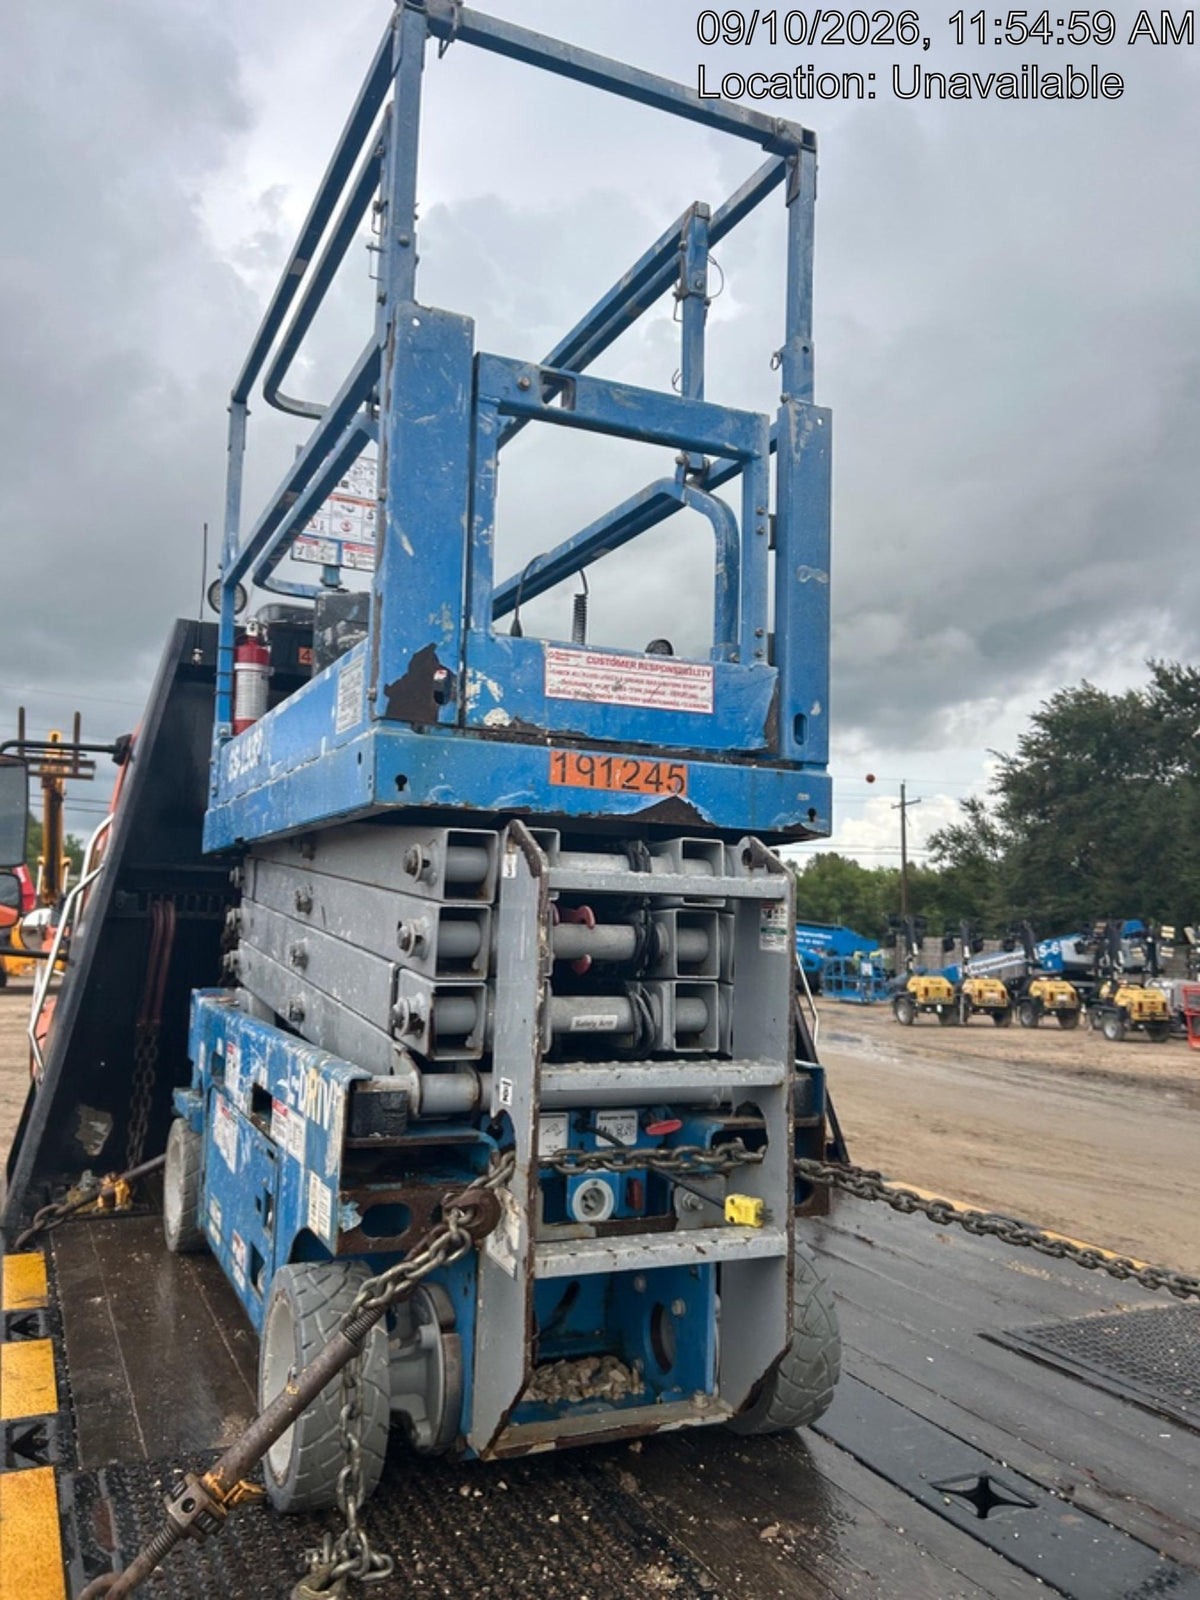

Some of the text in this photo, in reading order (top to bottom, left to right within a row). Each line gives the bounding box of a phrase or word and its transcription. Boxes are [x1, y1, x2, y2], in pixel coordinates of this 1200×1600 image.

[585, 655, 637, 670] CUSTOMER
[638, 660, 711, 678] RESPONSIBILITY
[554, 751, 686, 794] 191245
